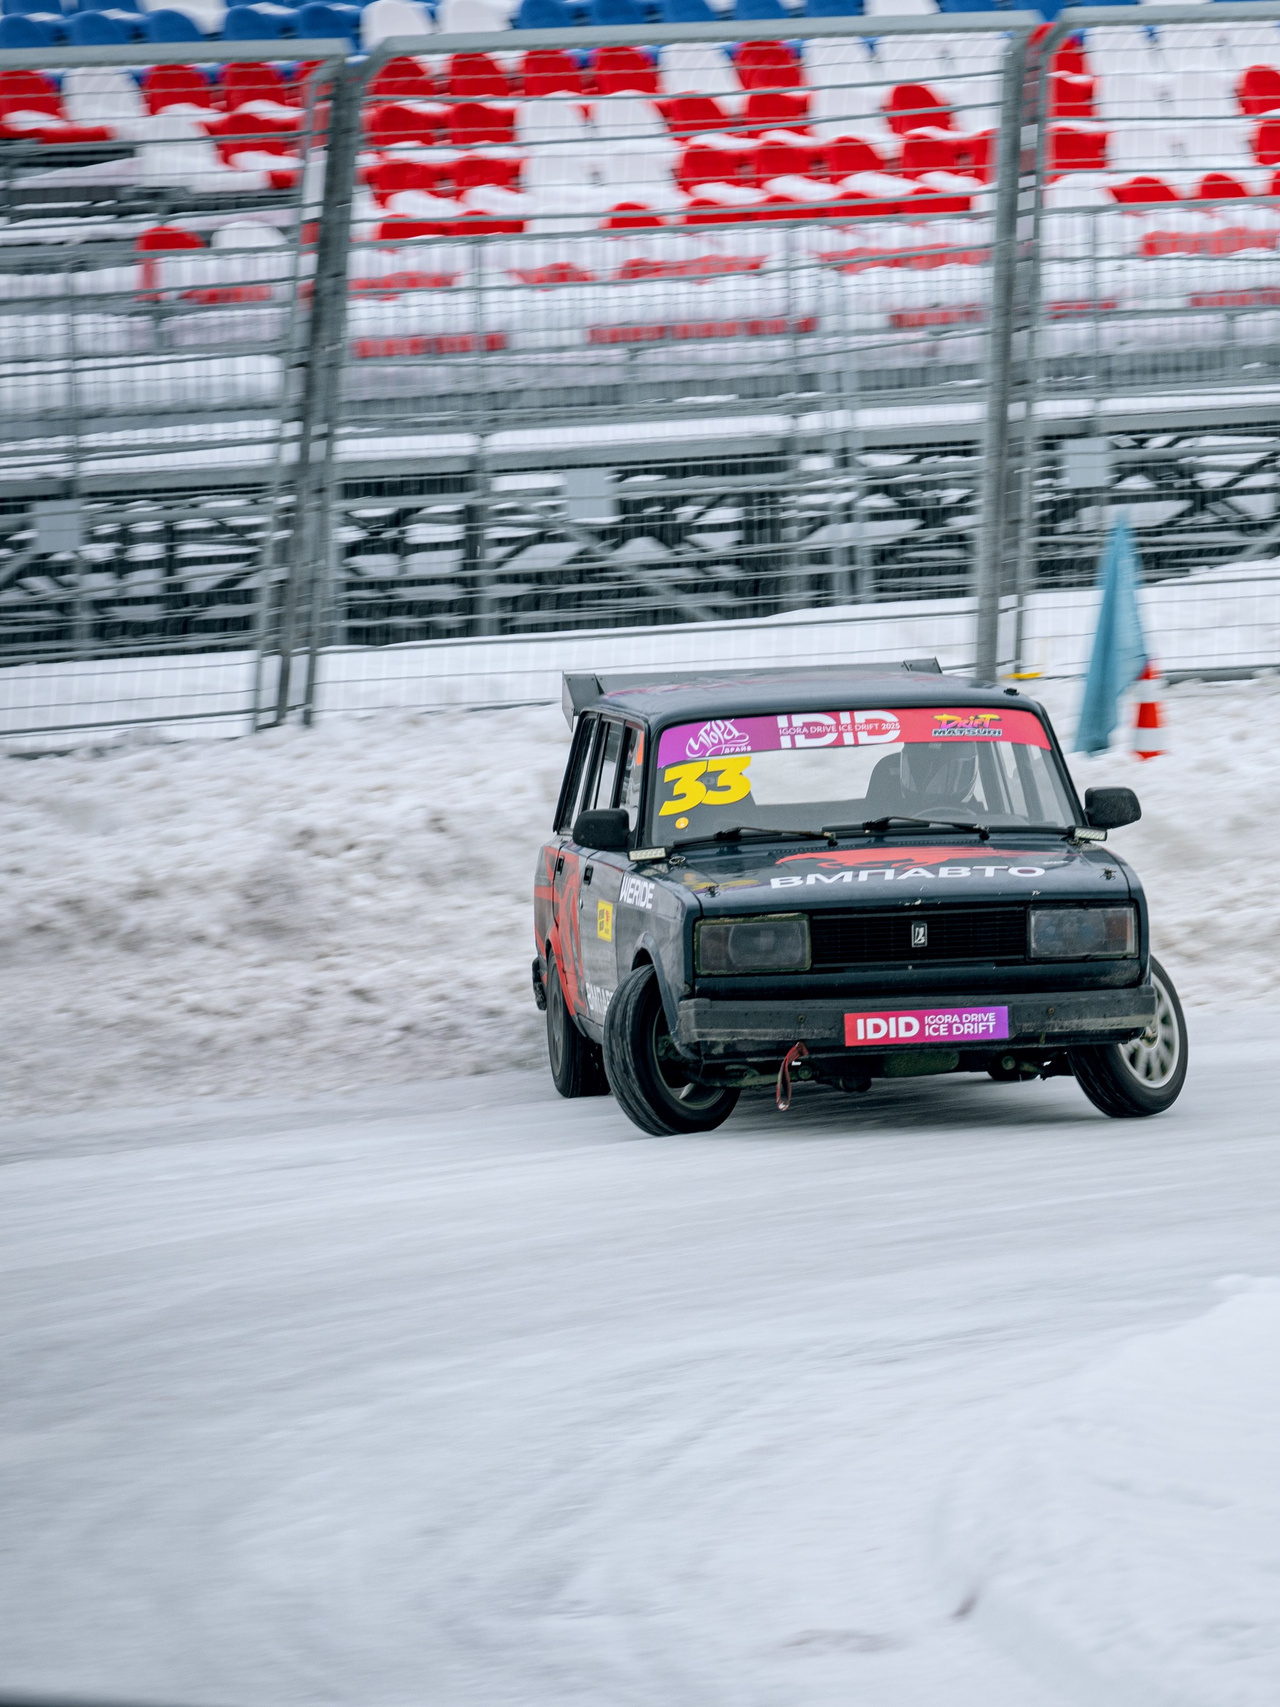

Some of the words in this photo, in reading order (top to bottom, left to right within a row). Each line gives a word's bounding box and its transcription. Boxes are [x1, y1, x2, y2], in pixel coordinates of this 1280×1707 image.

[776, 710, 901, 749] IDID
[779, 726, 809, 736] IGORA
[810, 724, 837, 734] DRIVE
[838, 723, 853, 732] ICE
[854, 722, 879, 732] DRIFT
[658, 755, 751, 816] 33
[770, 865, 1046, 889] ВМПАВТО
[856, 1016, 920, 1040] IDID
[924, 1014, 960, 1025] IGORA
[962, 1012, 996, 1023] DRIVE
[925, 1023, 949, 1037] ICE
[952, 1022, 996, 1036] DRIFT
